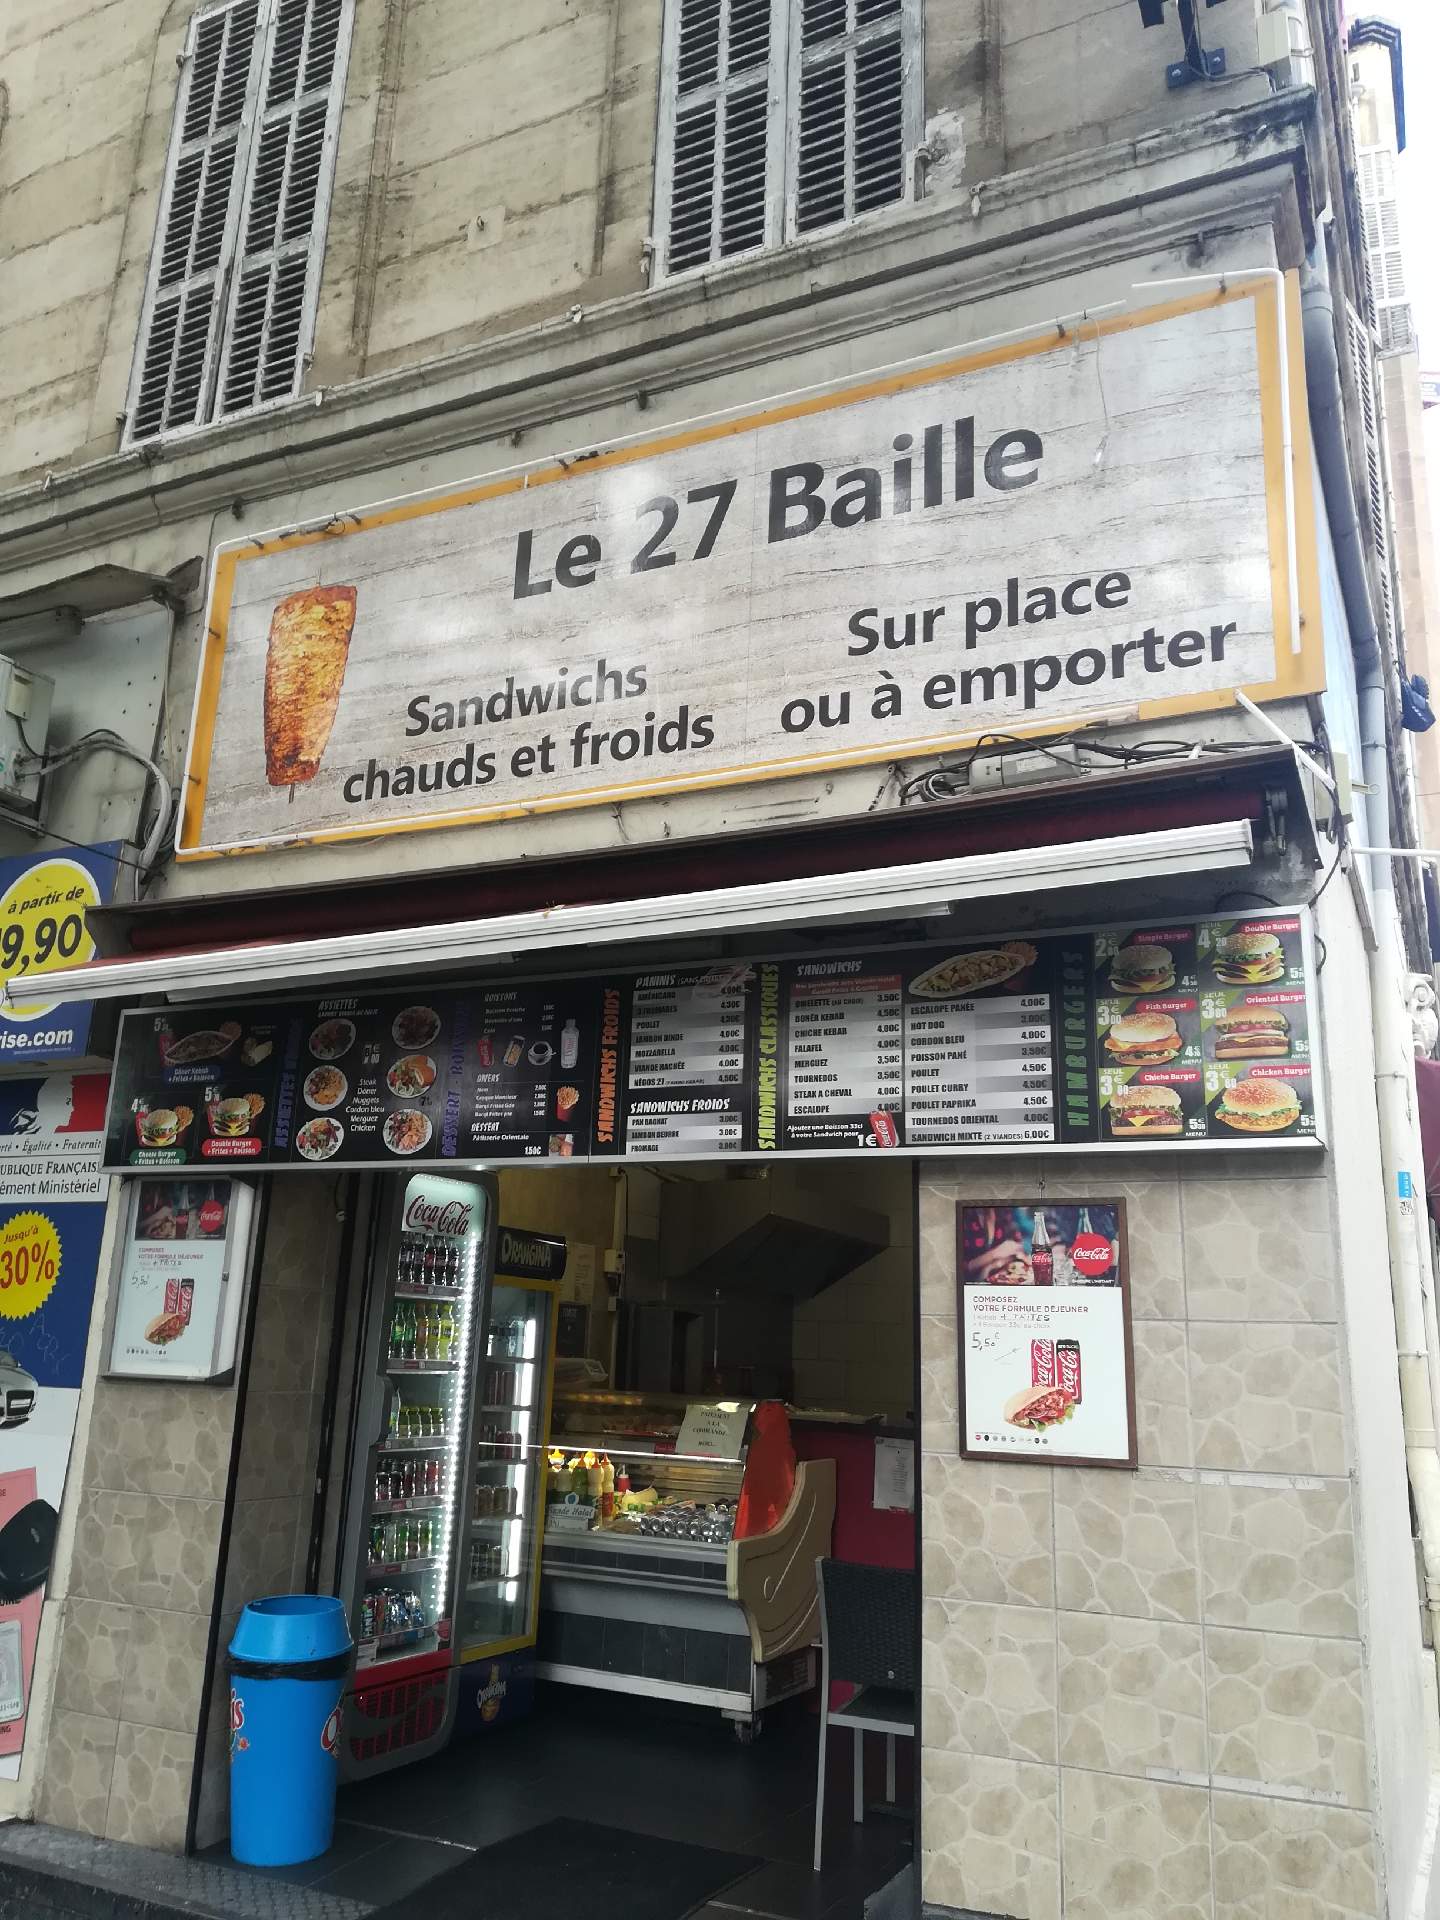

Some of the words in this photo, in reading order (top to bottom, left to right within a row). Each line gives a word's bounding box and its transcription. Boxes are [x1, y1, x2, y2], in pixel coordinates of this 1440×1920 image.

[513, 530, 601, 599] Le
[630, 480, 738, 574] 27
[767, 416, 1044, 544] Baille
[847, 606, 945, 657] Sur
[965, 571, 1131, 649] place
[780, 691, 850, 733] ou
[870, 669, 902, 719] à
[922, 621, 1237, 709] emporter
[405, 659, 647, 736] Sandwichs
[342, 743, 496, 803] chauds
[510, 735, 556, 778] et
[570, 705, 715, 769] froids
[7, 900, 17, 914] à
[19, 891, 63, 915] partir
[66, 886, 85, 901] de
[0, 914, 82, 976] 9,90
[796, 960, 863, 977] SANDWICHS
[635, 974, 677, 988] PANINIS
[759, 962, 780, 1055] CLASSIQUES
[910, 1004, 949, 1016] ESCALOPE
[601, 988, 620, 1045] FROIDS
[636, 1020, 661, 1031] POULET
[910, 1021, 927, 1031] HOT
[928, 1020, 945, 1030] DOG
[910, 1036, 944, 1047] CORDON
[945, 1035, 965, 1045] BLEU
[1063, 951, 1089, 1127] HAMBURGERS
[635, 1048, 676, 1058] MOZZARELLA
[795, 1043, 823, 1053] FALAFEL
[795, 1058, 828, 1068] MERGUEZ
[910, 1052, 946, 1062] POISSON
[794, 1073, 838, 1084] TOURNEDOS
[910, 1068, 940, 1078] POULET
[1252, 1068, 1283, 1077] Chicken
[794, 1089, 817, 1099] STEAK
[824, 1087, 853, 1098] CHEVAL
[911, 1084, 940, 1094] POULET
[941, 1082, 969, 1093] CURRY
[352, 1096, 380, 1106] Nuggets
[596, 1048, 618, 1144] SANDWICHS
[630, 1099, 691, 1114] SANDWICHS
[691, 1097, 731, 1112] FROIDS
[757, 1057, 778, 1150] SANDWICHS
[794, 1104, 830, 1115] ESCALOPE
[911, 1100, 940, 1110] POULET
[941, 1099, 976, 1110] PAPRIKA
[350, 1114, 378, 1124] Merguez
[441, 1091, 461, 1157] DESSERT
[911, 1116, 959, 1126] TOURNEDOS
[960, 1114, 1000, 1125] ORIENTAL
[350, 1124, 376, 1133] Chicken
[471, 1121, 500, 1132] DESSERT
[787, 1124, 811, 1133] Ajouter
[825, 1122, 849, 1131] Boisson
[814, 1130, 842, 1138] Sandwich
[843, 1131, 860, 1140] pour
[857, 1133, 877, 1147] 1€
[911, 1132, 956, 1143] SANDWICH
[957, 1131, 983, 1142] MIXTE
[62, 1138, 102, 1151] Fraternit
[46, 1161, 100, 1175] FRANÇAIS
[38, 1178, 101, 1195] Ministériel
[406, 1194, 474, 1236] Coca-Cola
[1073, 1246, 1112, 1260] Coca-Cola
[0, 1240, 55, 1289] 30%
[972, 1295, 1018, 1303] COMPOSEZ
[972, 1304, 1000, 1312] VOTRE
[1001, 1304, 1042, 1313] FORMULE
